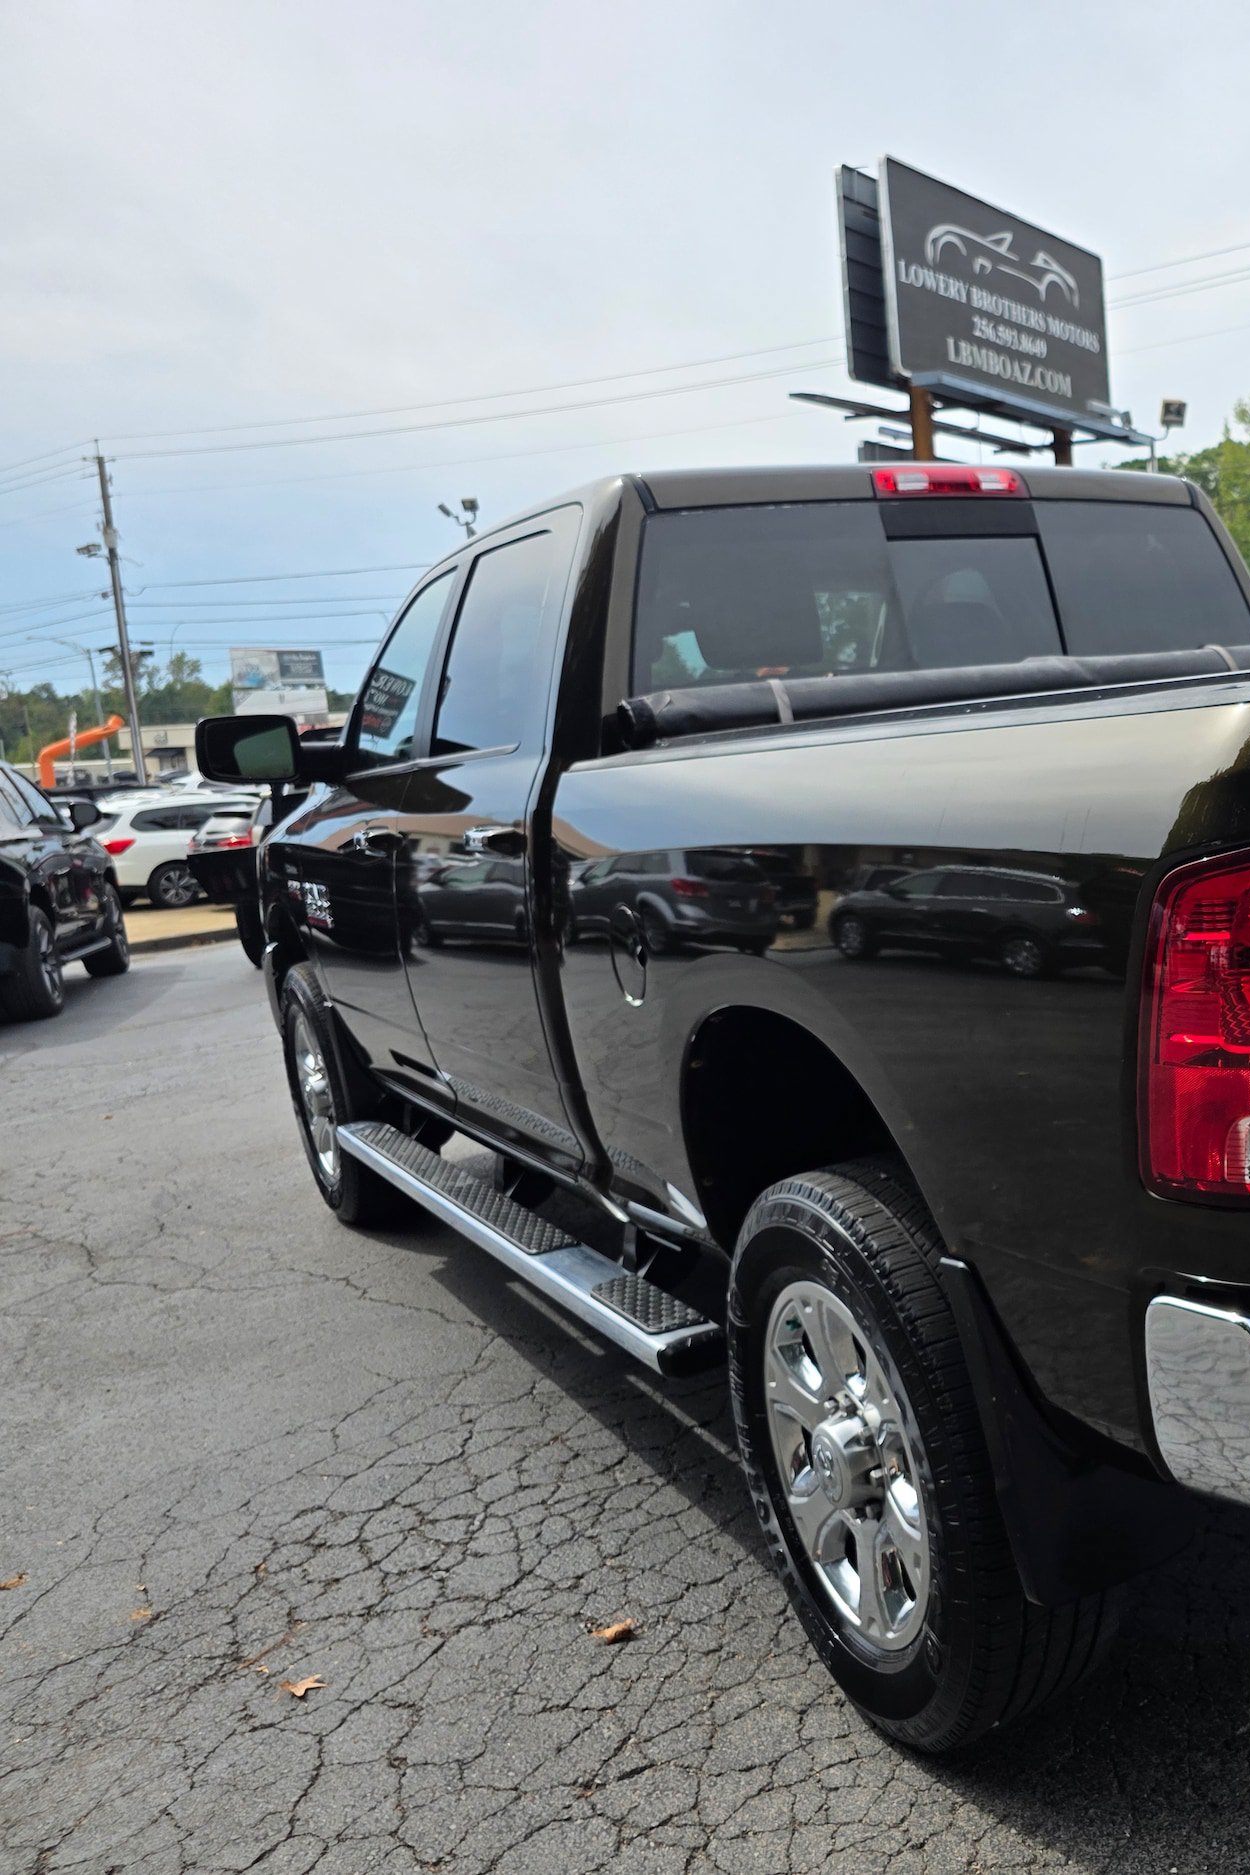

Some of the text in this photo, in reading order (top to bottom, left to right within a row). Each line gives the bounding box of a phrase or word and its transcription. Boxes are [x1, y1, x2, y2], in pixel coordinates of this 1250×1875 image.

[898, 258, 1100, 354] LOWERY BROTHERS MOTORS
[946, 335, 1073, 398] LBMBOAZ.COM
